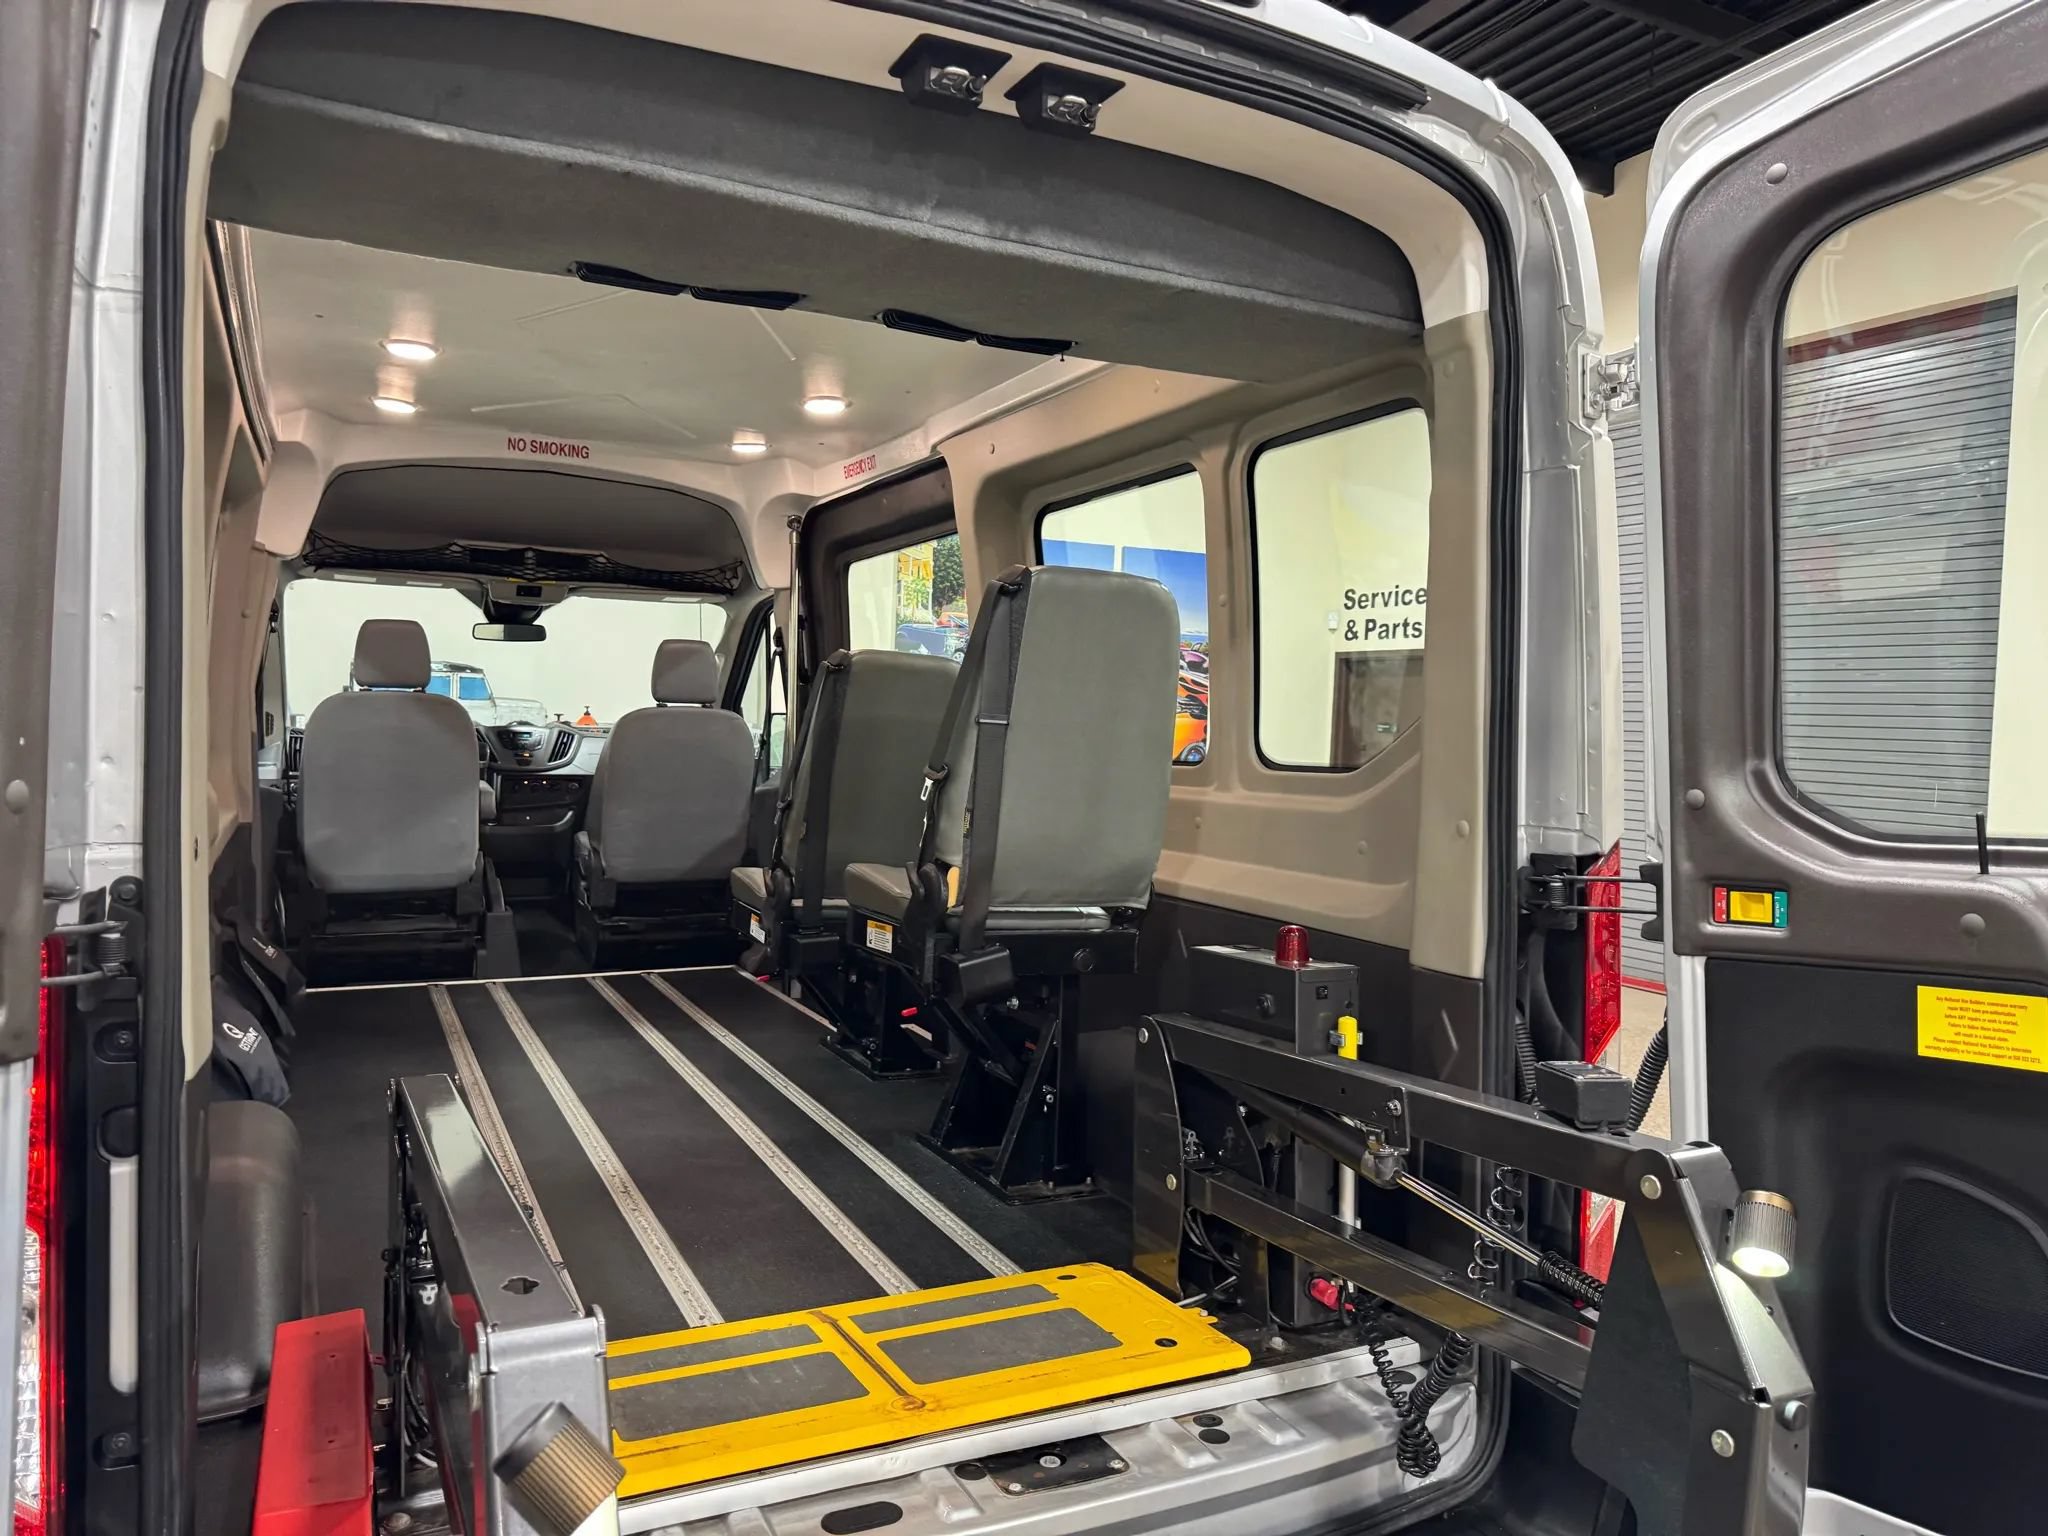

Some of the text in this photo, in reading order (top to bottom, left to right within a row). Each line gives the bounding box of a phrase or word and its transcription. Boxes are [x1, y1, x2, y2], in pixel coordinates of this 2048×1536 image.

[508, 437, 590, 459] NO SMOKING
[1344, 585, 1428, 610] Service
[1344, 617, 1423, 641] & Parts
